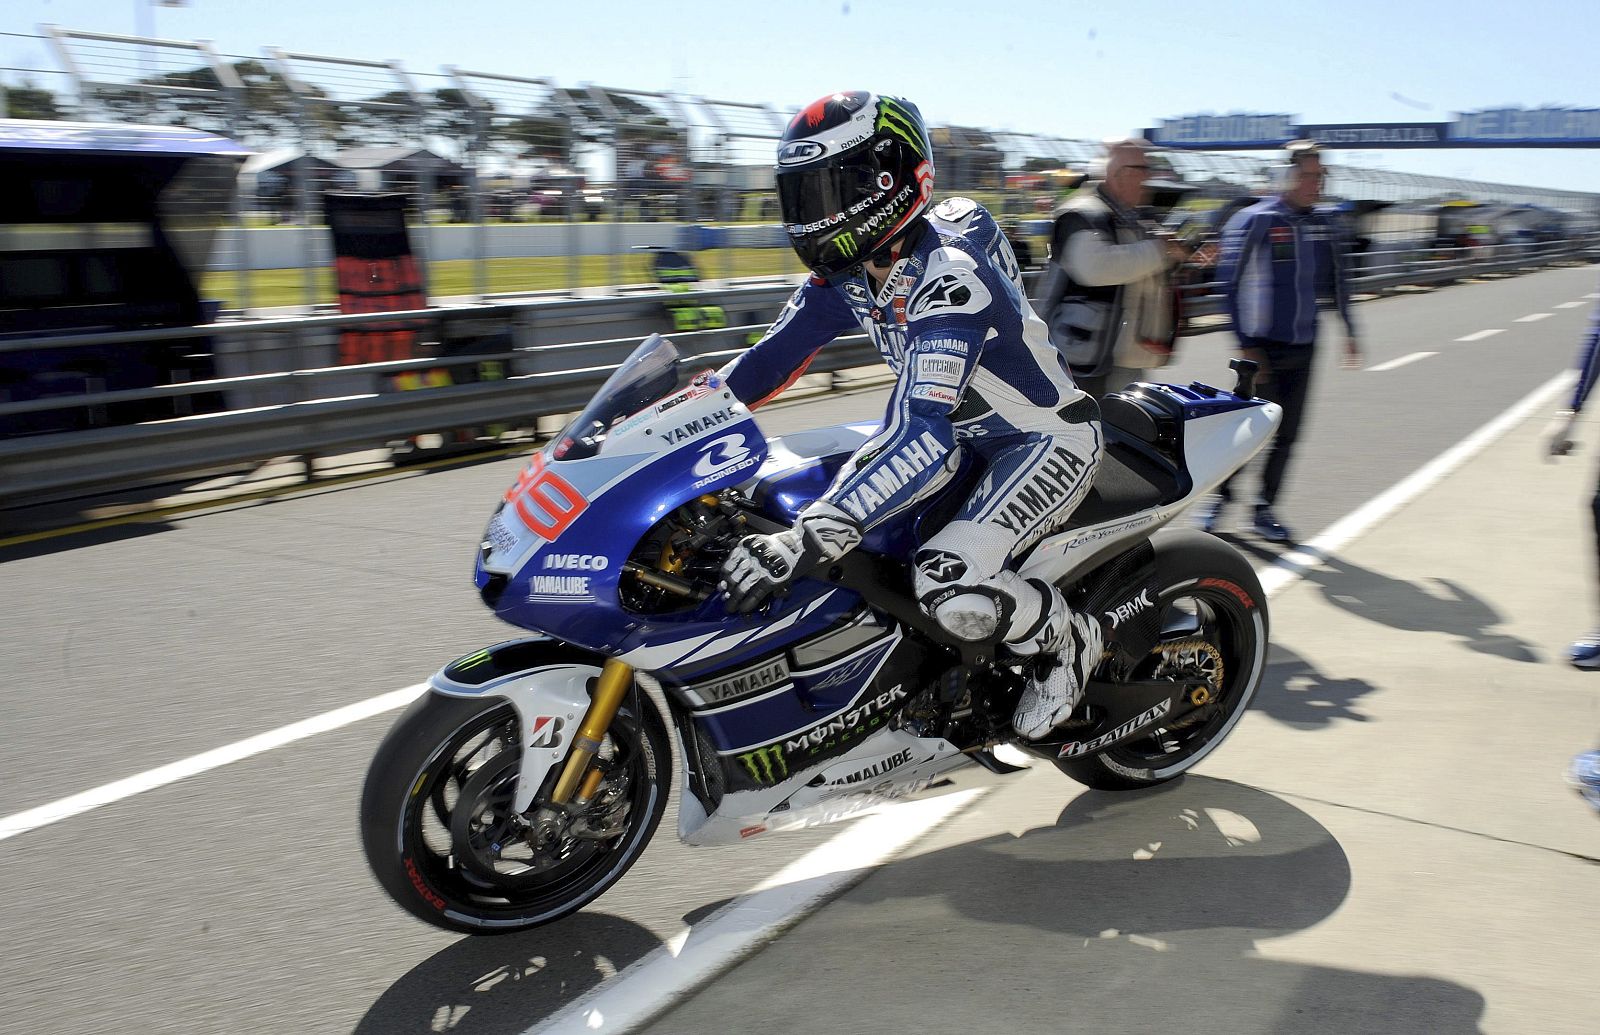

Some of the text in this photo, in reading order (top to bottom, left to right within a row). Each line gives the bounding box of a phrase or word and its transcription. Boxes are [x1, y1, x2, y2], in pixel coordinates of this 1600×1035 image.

[840, 134, 867, 150] RPHA
[930, 338, 969, 354] YAMAHA
[840, 430, 949, 522] YAMAHA
[991, 445, 1087, 537] YAMAHA
[546, 553, 609, 571] IVECO
[530, 575, 592, 596] YAMALUBE
[708, 661, 786, 702] YAMAHA
[784, 683, 908, 754] MONSTER
[810, 709, 893, 756] ENERGY
